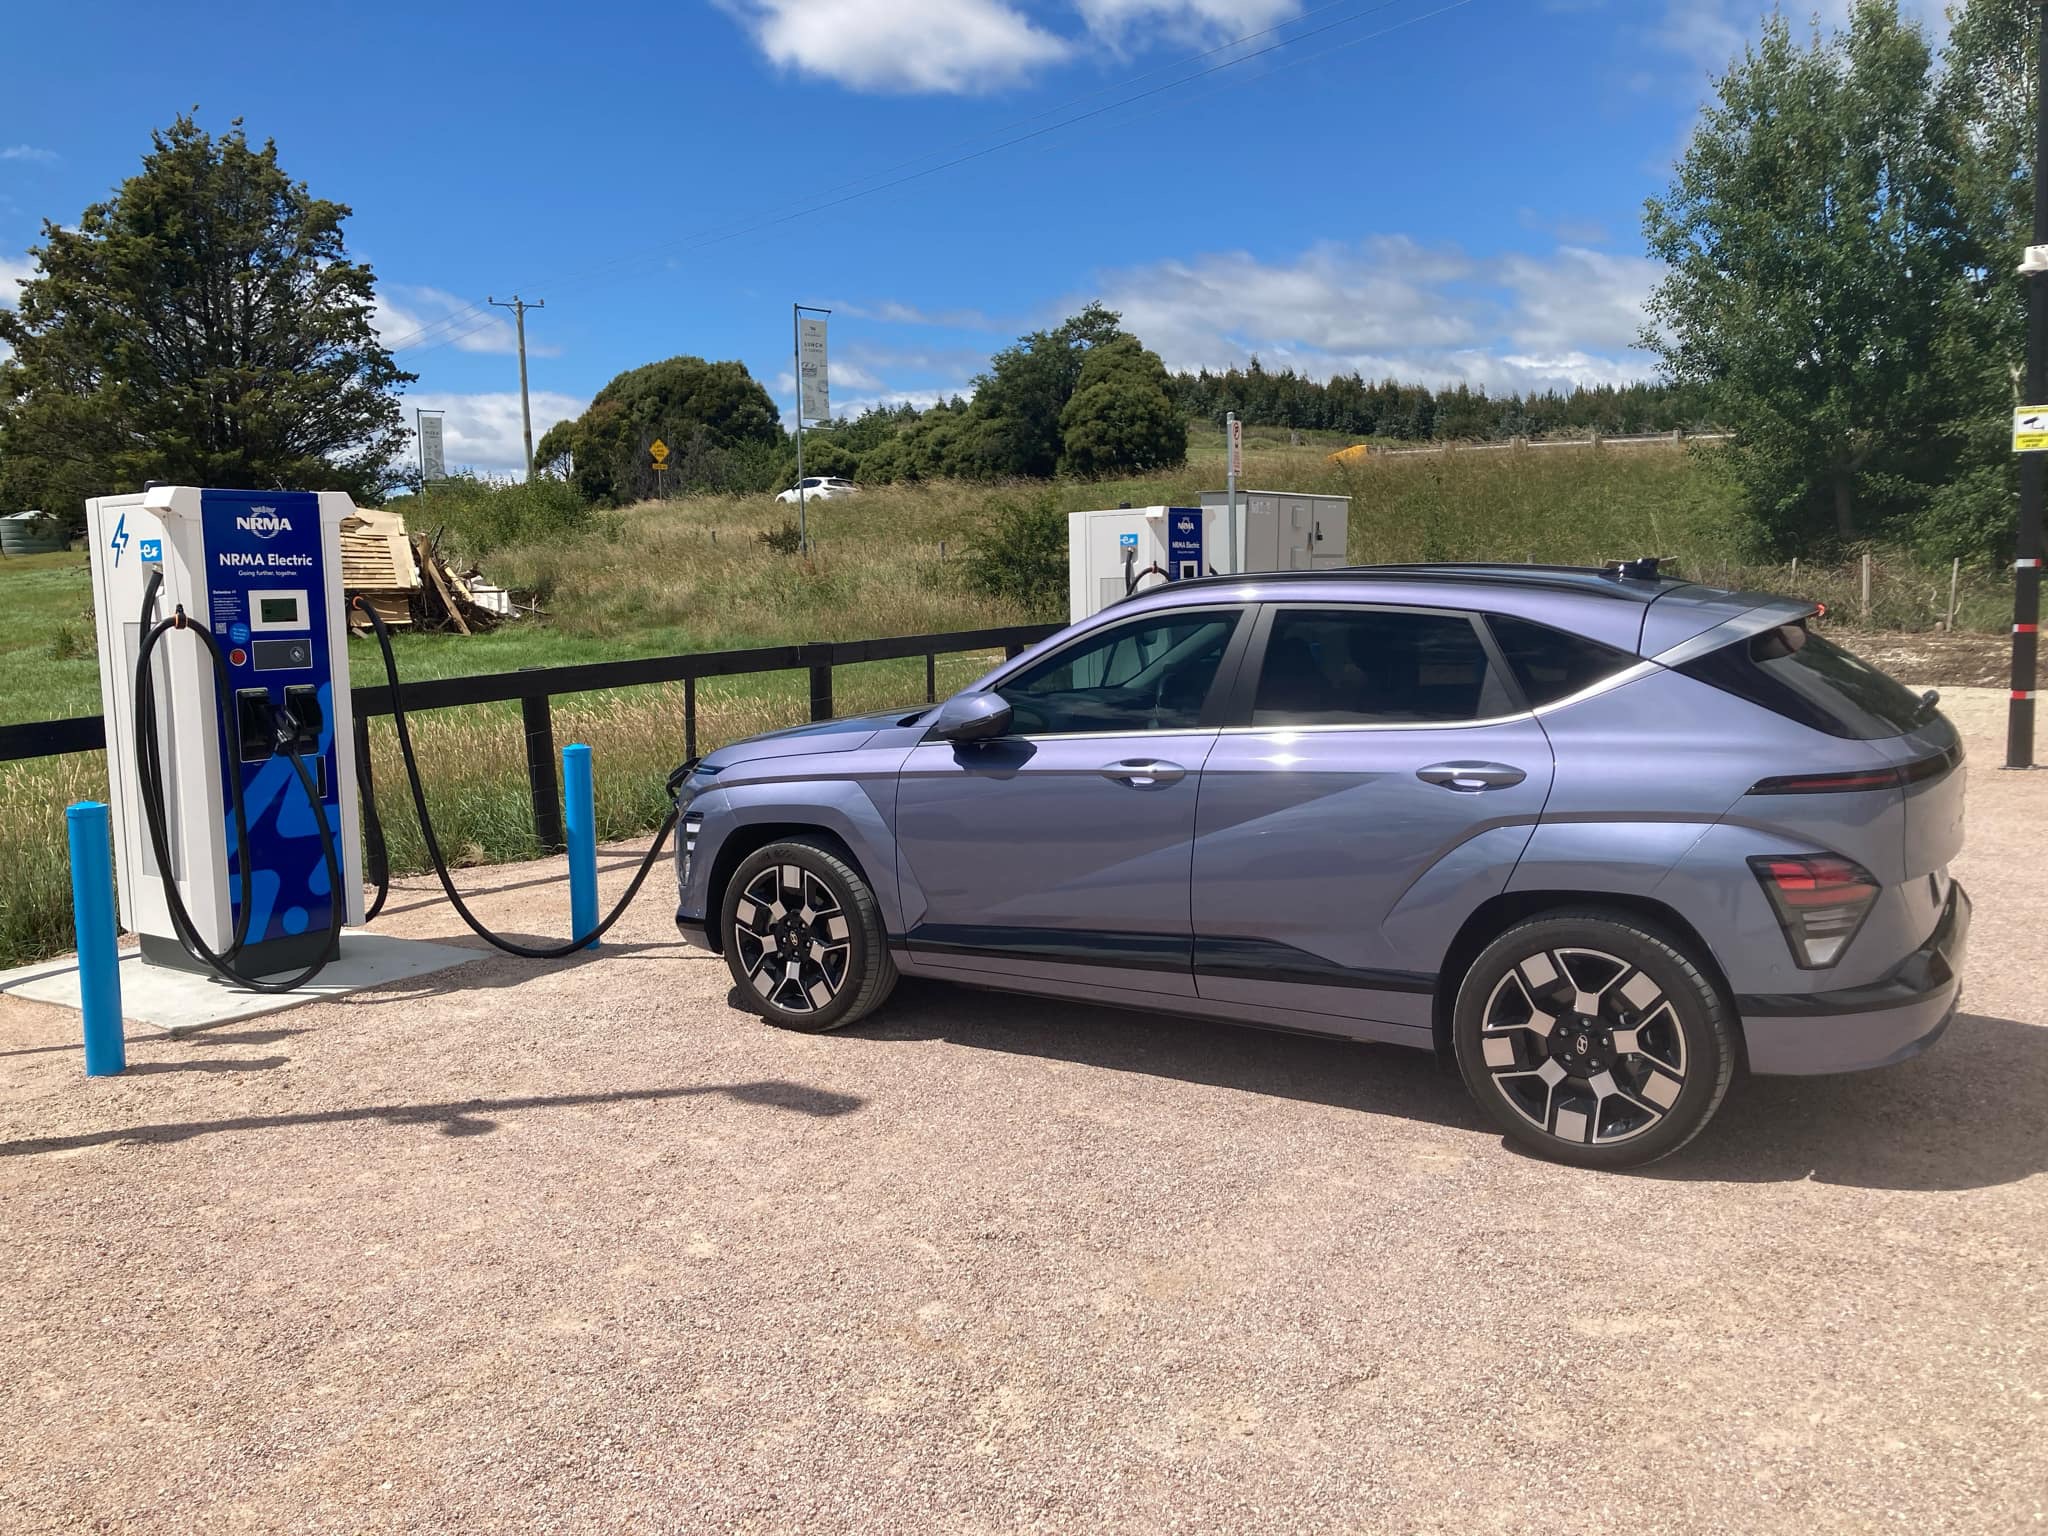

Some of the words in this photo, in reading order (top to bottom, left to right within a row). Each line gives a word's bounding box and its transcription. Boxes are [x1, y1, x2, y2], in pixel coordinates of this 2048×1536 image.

[236, 516, 293, 531] NRMA
[219, 553, 265, 566] NRMA
[267, 553, 313, 566] Electric
